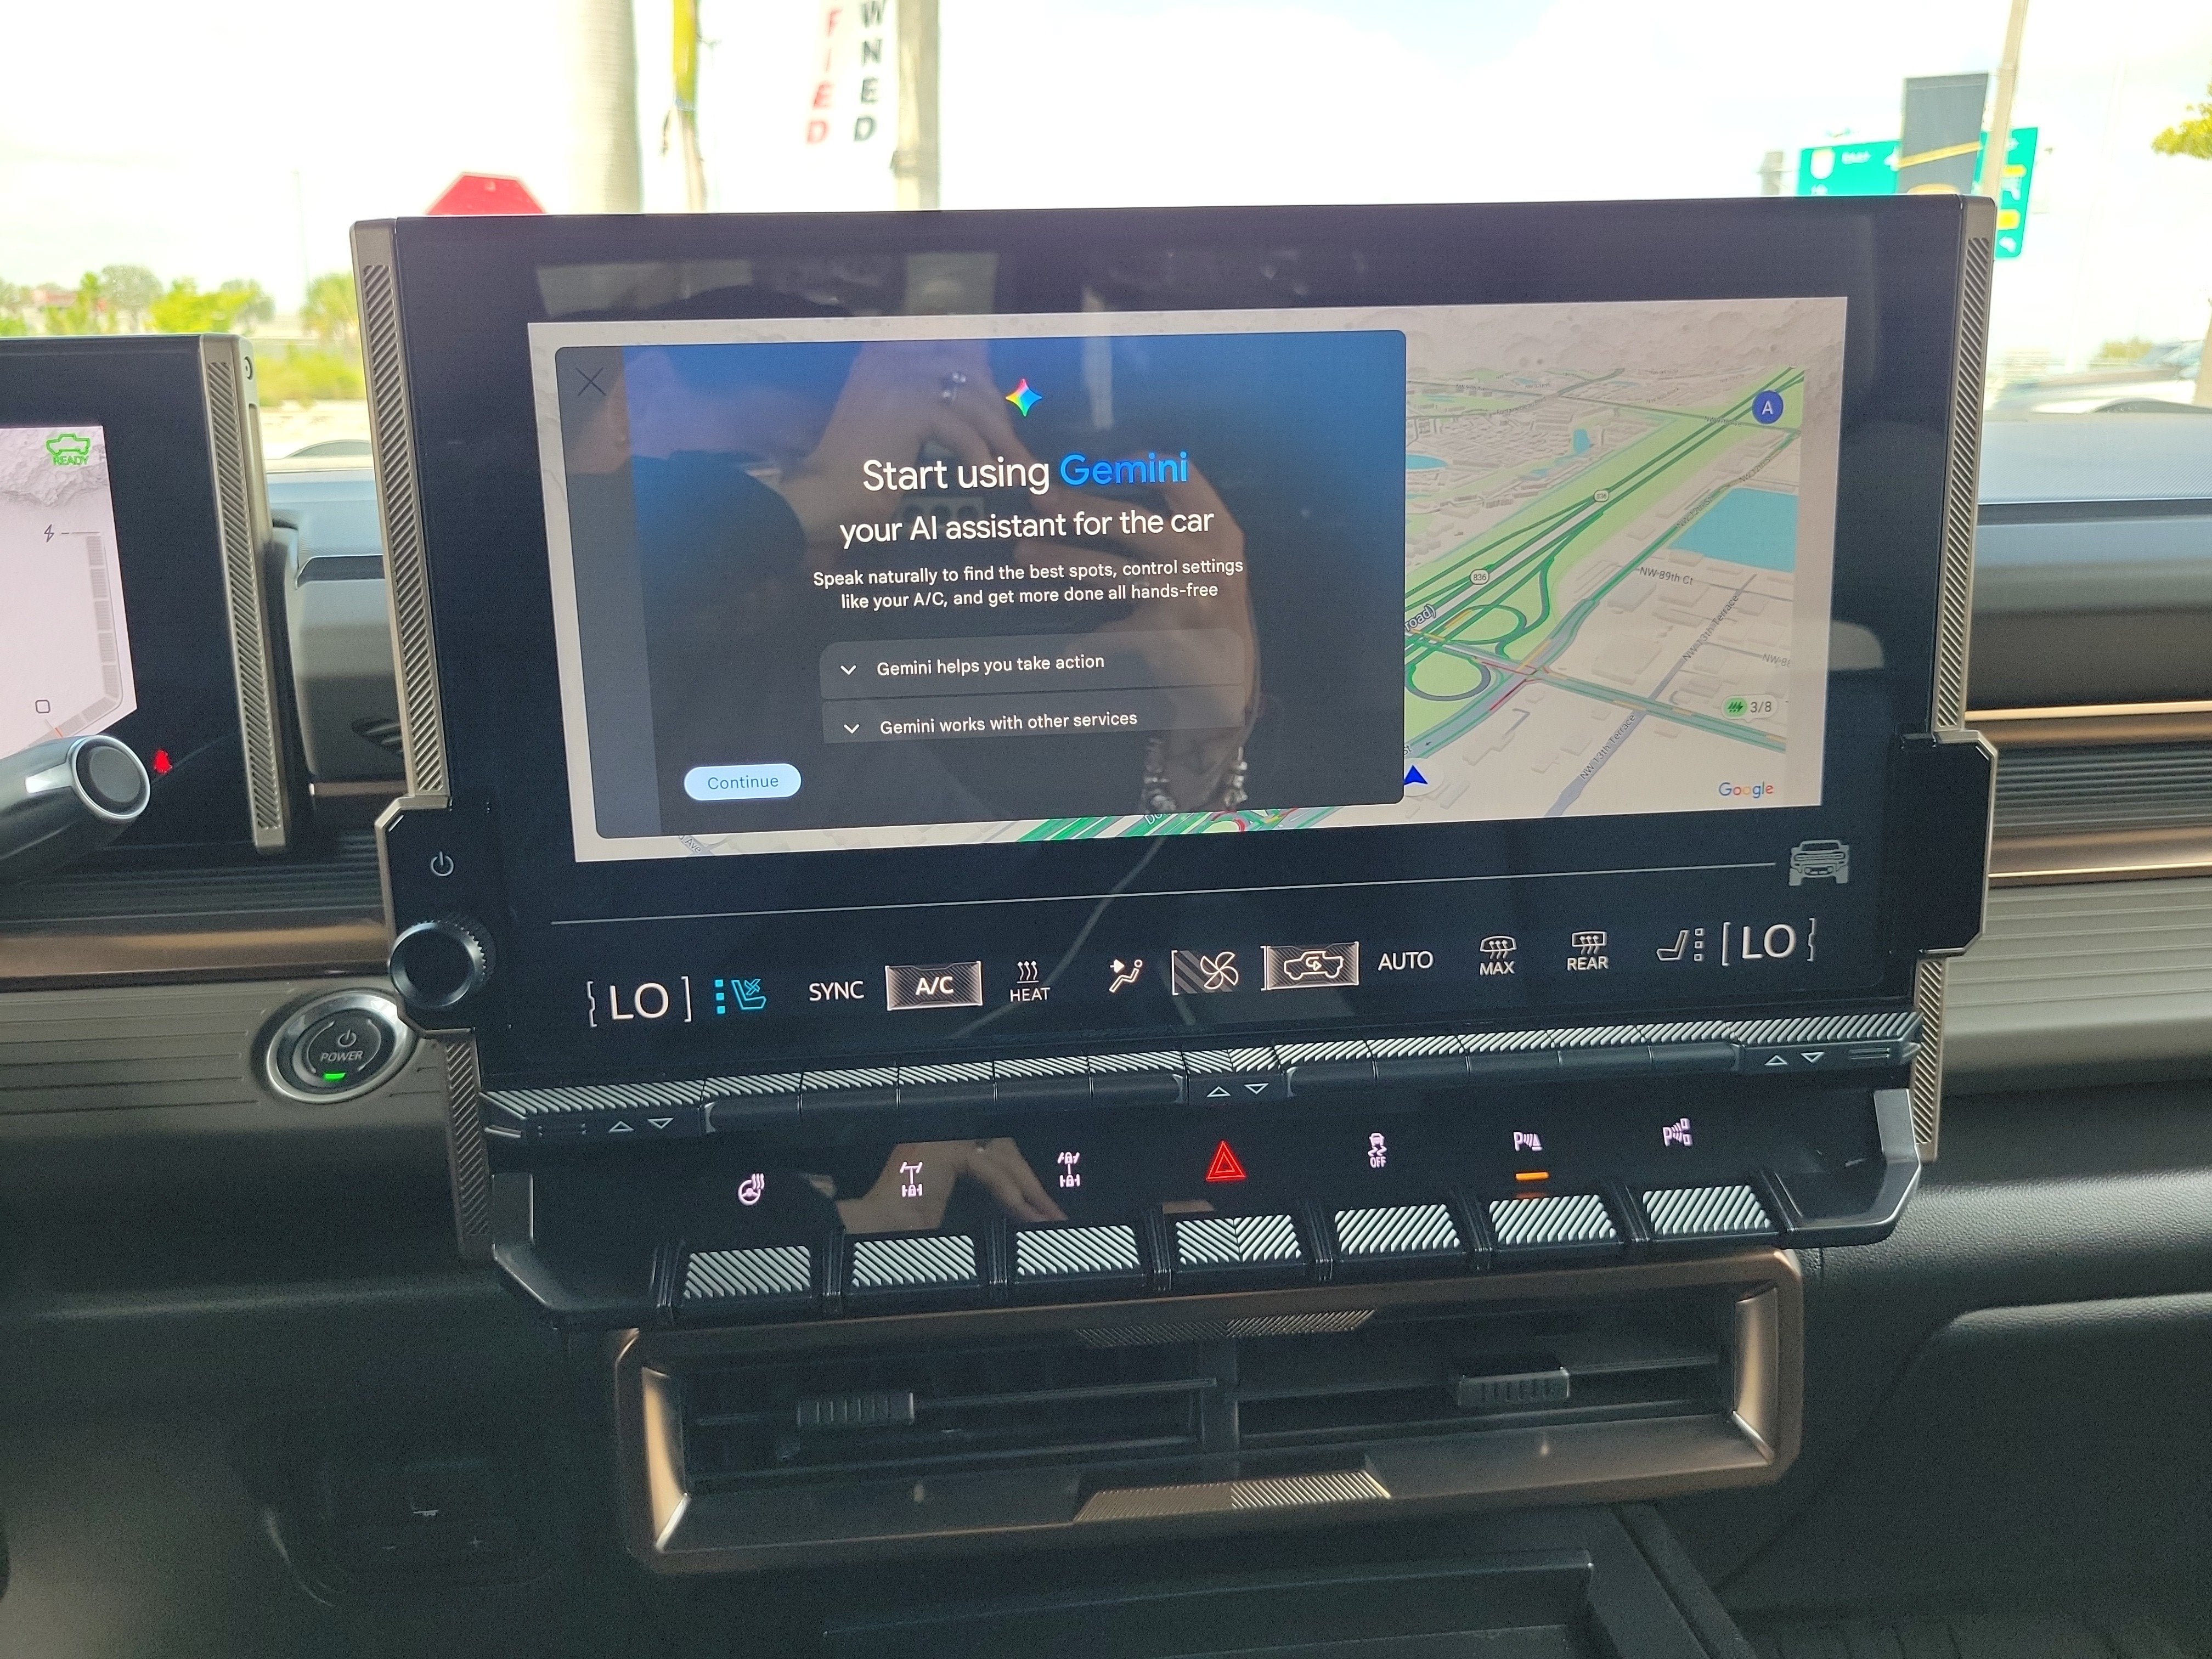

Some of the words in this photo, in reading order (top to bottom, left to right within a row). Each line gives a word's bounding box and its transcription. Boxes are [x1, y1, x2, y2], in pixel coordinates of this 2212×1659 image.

[1762, 400, 1774, 415] A
[53, 455, 89, 466] READY
[863, 459, 948, 491] Start
[958, 456, 1049, 495] using
[1060, 451, 1189, 486] Gemini
[839, 520, 902, 549] your
[910, 515, 937, 540] AI
[946, 514, 1066, 540] assistant
[1073, 511, 1113, 536] for
[1119, 510, 1164, 534] the
[1171, 512, 1215, 533] car
[814, 570, 864, 589] Speak
[868, 567, 938, 586] naturally
[942, 569, 958, 582] to
[963, 565, 994, 581] find
[998, 565, 1025, 580] the
[1030, 564, 1064, 579] best
[1069, 563, 1117, 583] spots,
[1122, 560, 1177, 576] control
[1182, 557, 1244, 577] settings
[1640, 567, 1657, 578] NW
[1659, 571, 1680, 582] 89th
[1683, 575, 1693, 585] Ct
[842, 594, 869, 609] like
[873, 596, 909, 612] your
[913, 591, 947, 610] A/C,
[953, 589, 983, 605] and
[988, 590, 1014, 608] get
[1019, 591, 1059, 602] more
[1064, 586, 1104, 601] done
[1108, 584, 1126, 600] all
[1131, 582, 1218, 599] hands-free
[1681, 647, 1697, 661] NW
[1712, 595, 1739, 625] Terrace
[877, 659, 932, 676] Gemini
[937, 658, 980, 678] helps
[983, 661, 1012, 676] you
[1017, 656, 1051, 670] take
[1056, 654, 1104, 669] action
[1750, 701, 1771, 713] 3/8
[880, 718, 934, 735] Gemini
[939, 716, 985, 732] works
[990, 715, 1023, 730] with
[1028, 713, 1069, 729] other
[1073, 711, 1137, 727] services
[1579, 763, 1594, 780] NW
[1593, 746, 1611, 763] 13th
[1608, 715, 1635, 743] Terrace
[708, 775, 778, 789] Continue
[1718, 781, 1774, 798] Google
[1742, 924, 1797, 959] LO
[1378, 951, 1434, 971] AUTO
[1480, 961, 1515, 976] MAX
[1567, 956, 1609, 971] REAR
[809, 980, 865, 1001] SYNC
[915, 976, 954, 995] A/C
[1009, 987, 1051, 1002] HEAT
[610, 983, 669, 1020] LO
[320, 1051, 363, 1062] POWER
[1369, 1156, 1386, 1169] OFF
